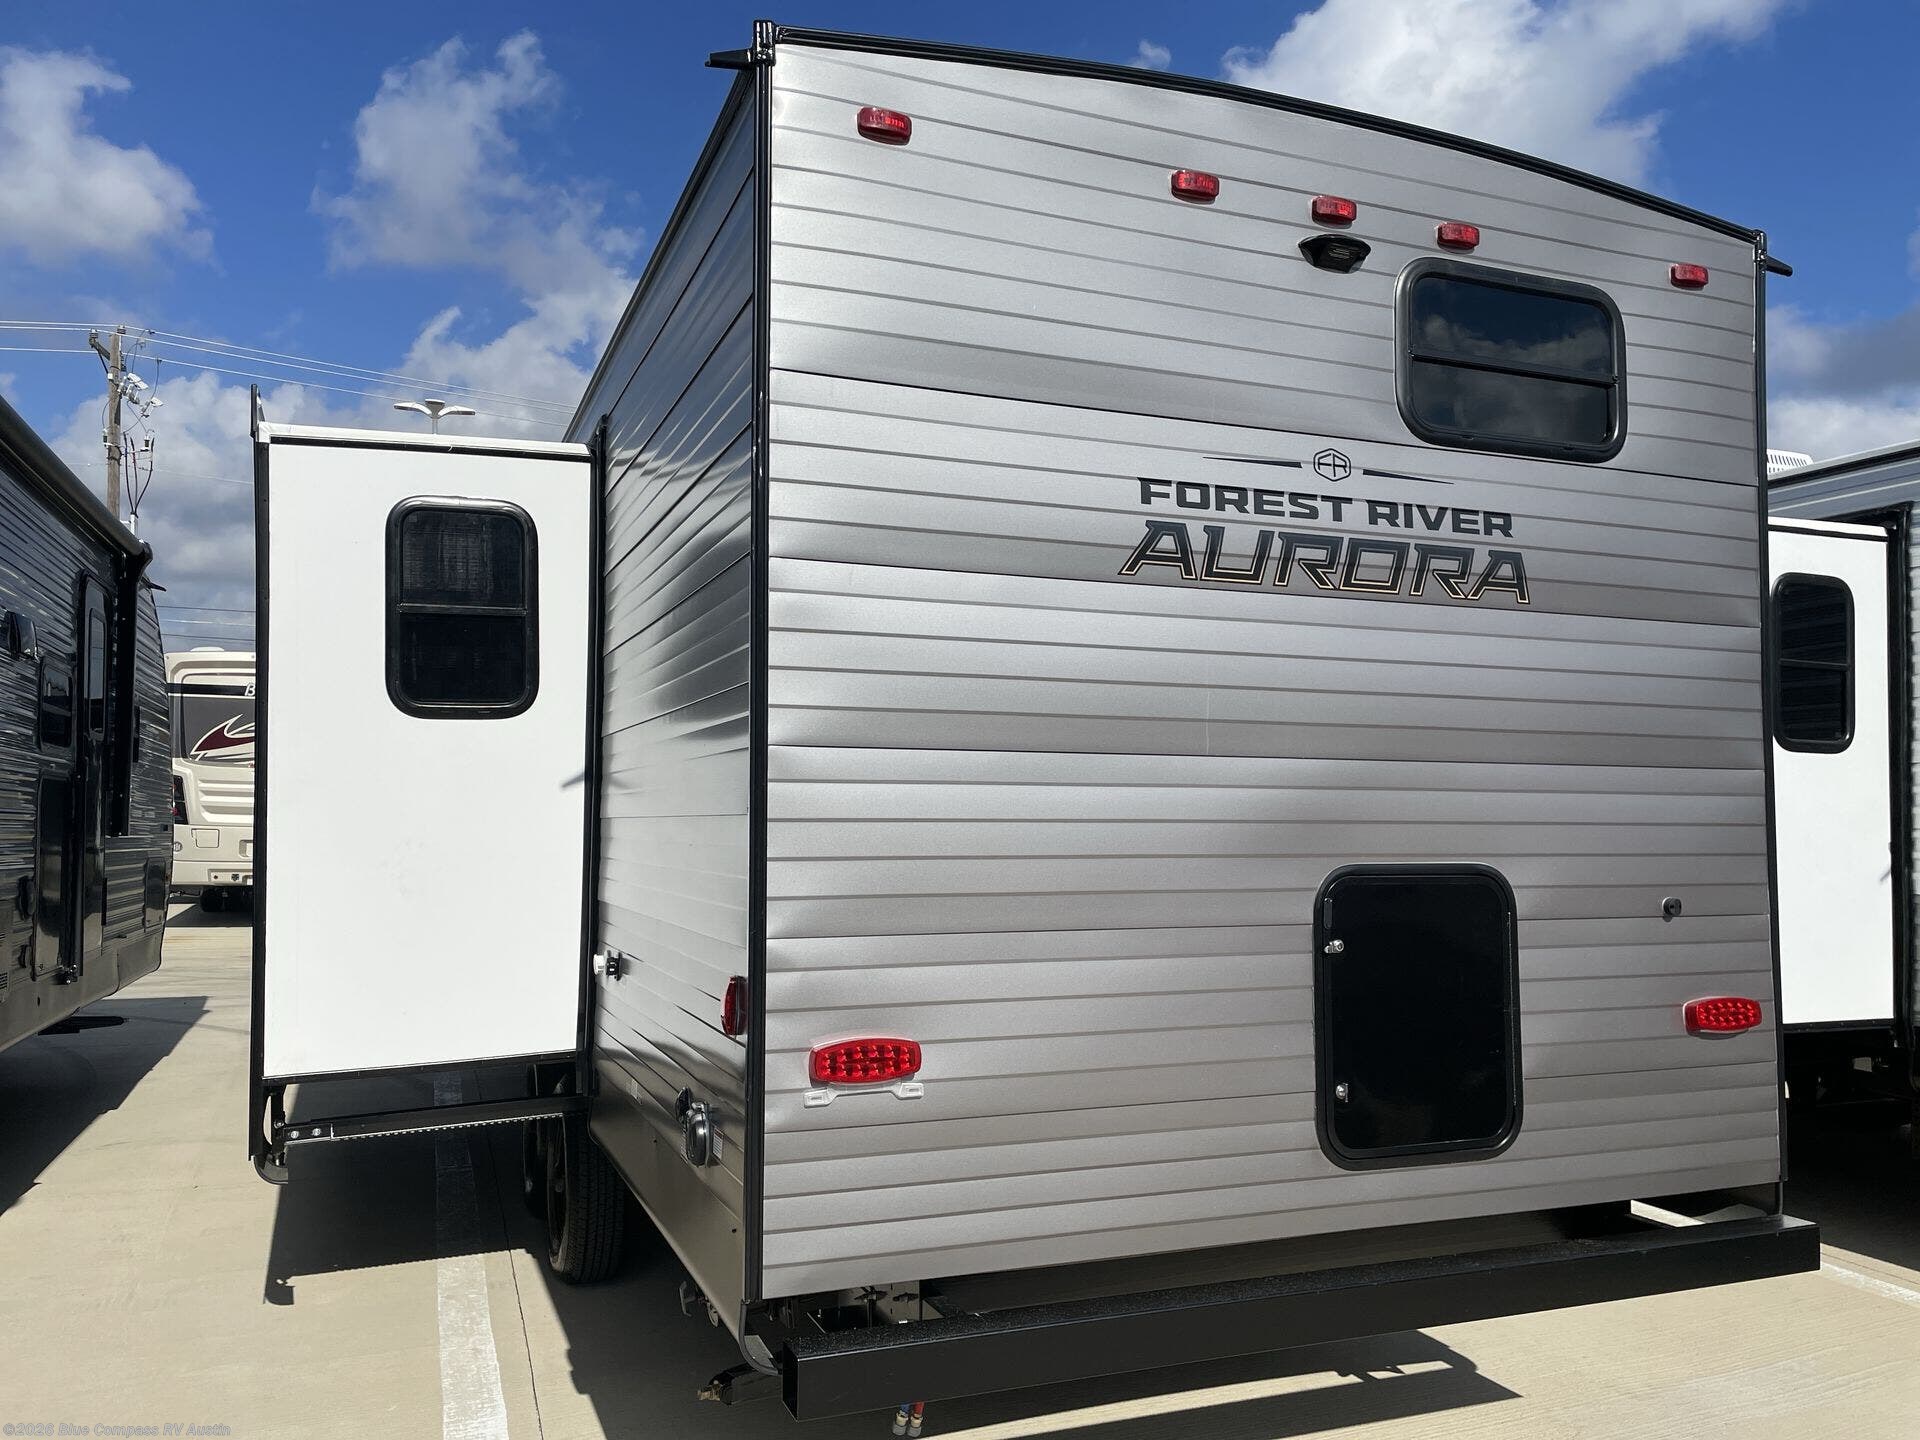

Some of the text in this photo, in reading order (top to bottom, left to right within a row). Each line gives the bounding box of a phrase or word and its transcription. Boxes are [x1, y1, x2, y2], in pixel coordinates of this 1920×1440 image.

[1137, 477, 1514, 538] FOREST RIVER
[1118, 520, 1531, 604] AURORA
